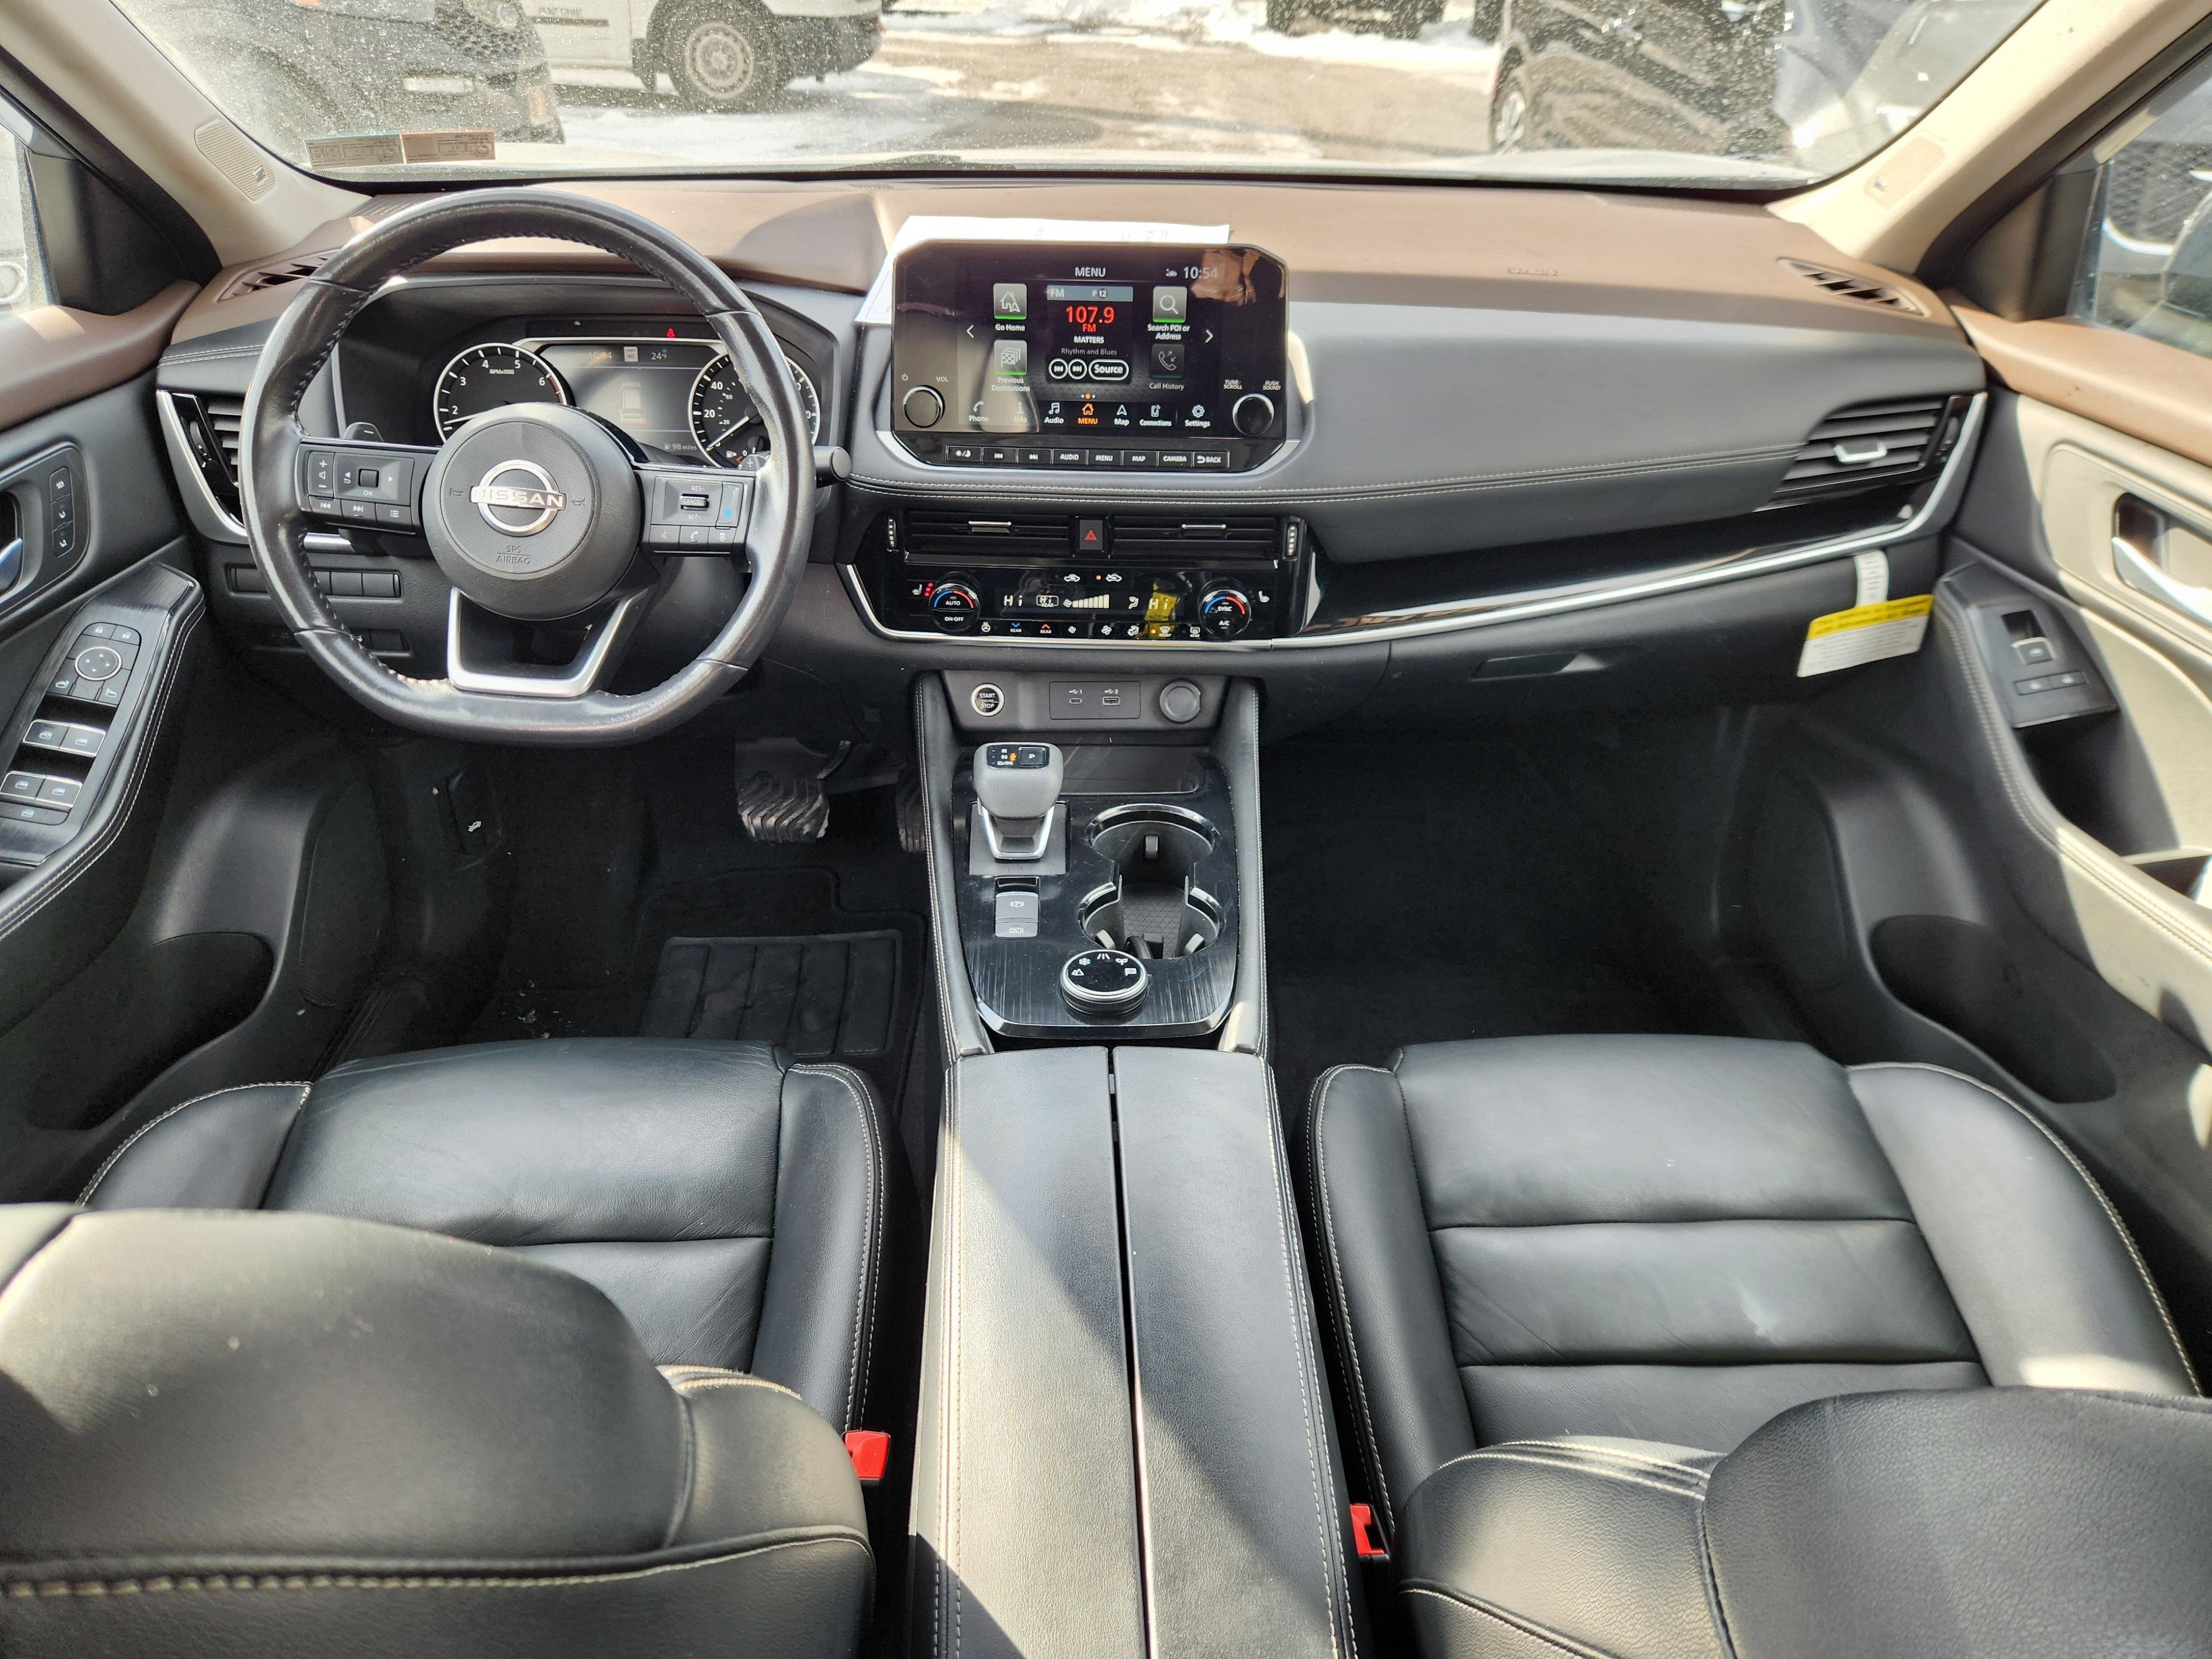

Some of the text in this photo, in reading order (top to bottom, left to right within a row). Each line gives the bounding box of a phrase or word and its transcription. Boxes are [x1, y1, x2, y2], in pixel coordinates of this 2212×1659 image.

[1074, 267, 1106, 277] MENU
[1183, 267, 1218, 279] 10:54
[1051, 289, 1065, 298] FM
[1066, 306, 1115, 324] 107.9
[1082, 324, 1096, 332] FM
[1147, 324, 1169, 332] Search
[1073, 336, 1104, 344] MATTERS
[1155, 332, 1182, 341] Address
[482, 359, 489, 369] 4
[514, 359, 521, 369] 5
[1093, 364, 1124, 374] Source
[460, 377, 466, 386] 3
[539, 377, 546, 386] 6
[711, 382, 723, 390] 40
[452, 405, 458, 415] 2
[704, 409, 716, 418] 20
[1114, 418, 1130, 426] Map
[1139, 419, 1172, 427] Connections
[1185, 419, 1211, 428] Settings
[474, 489, 564, 508] NISSAN
[507, 545, 522, 554] SRS
[497, 555, 531, 565] AIRBAG
[1004, 595, 1023, 607] Hi
[1149, 598, 1168, 609] Hi
